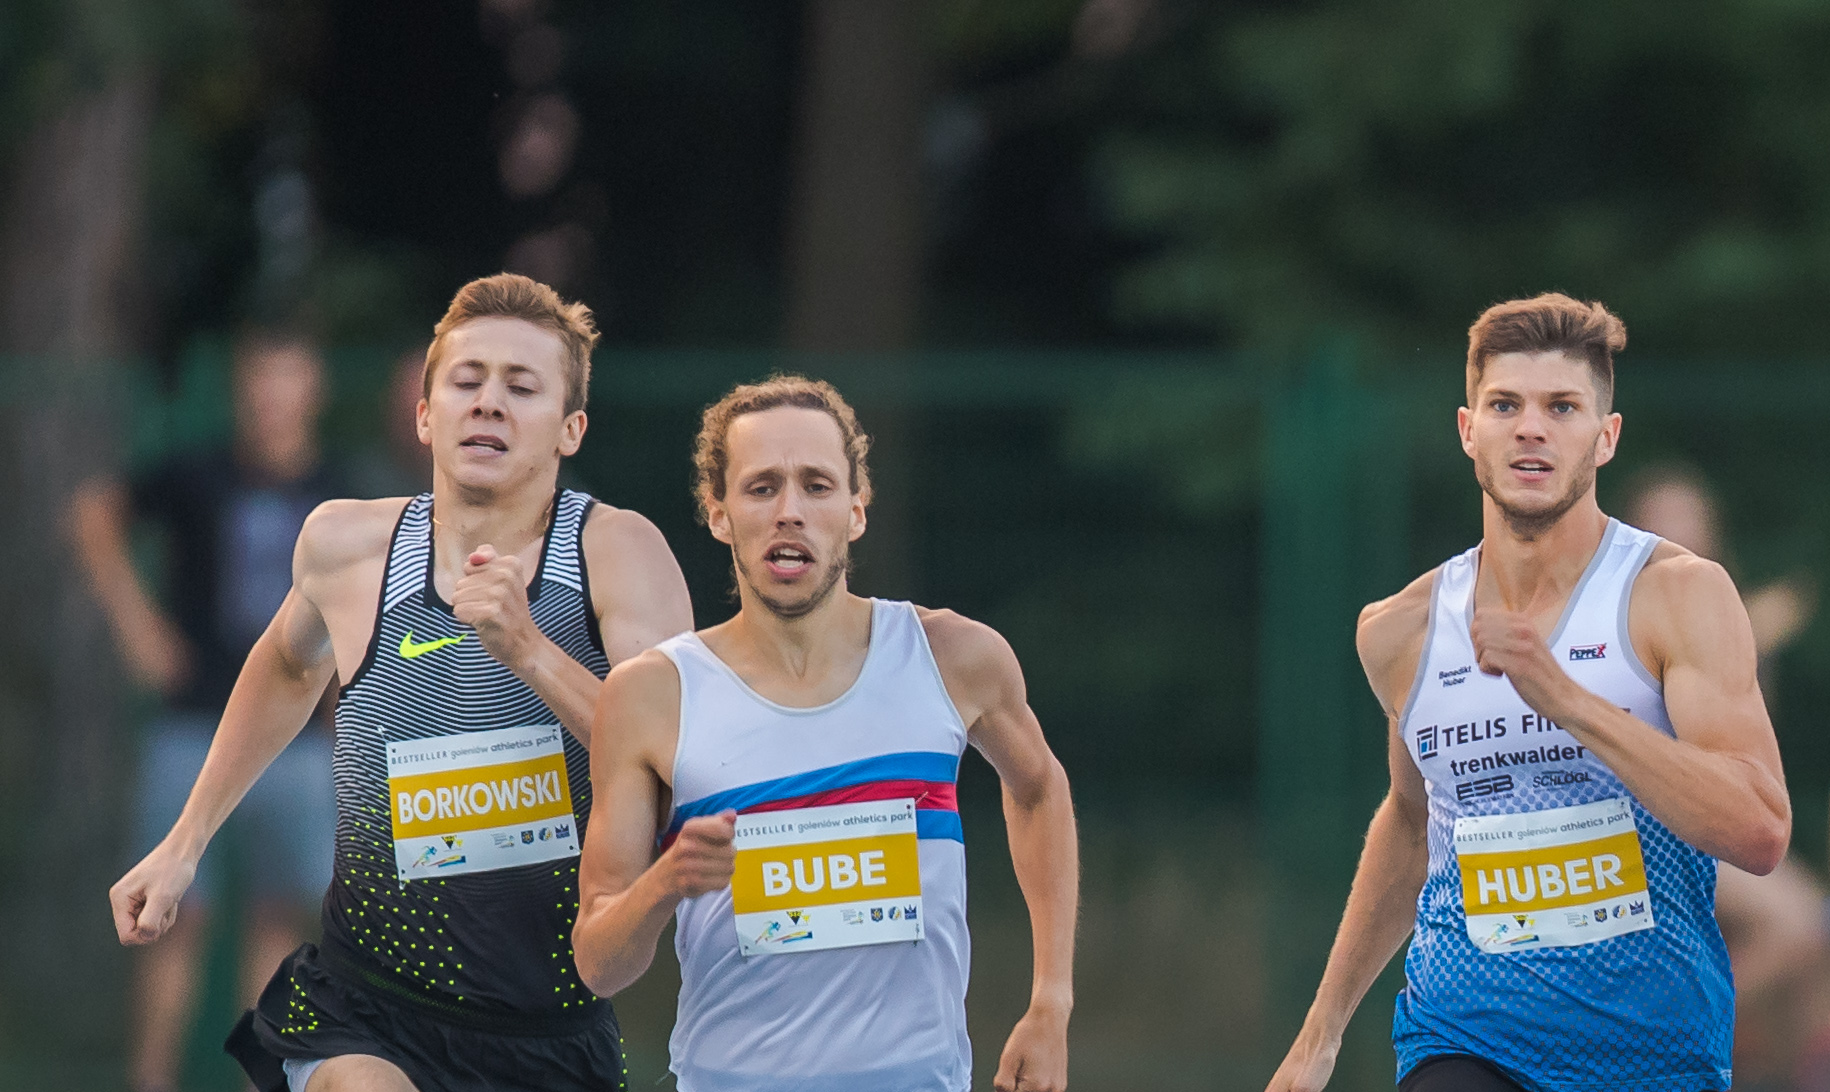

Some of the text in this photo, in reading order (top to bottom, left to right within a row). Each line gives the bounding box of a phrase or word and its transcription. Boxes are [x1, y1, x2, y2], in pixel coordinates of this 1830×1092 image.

[1442, 717, 1507, 747] TELIS
[391, 751, 448, 765] BESTSELLER
[490, 739, 533, 752] athletics
[536, 733, 560, 748] park
[1450, 745, 1586, 777] trenkwalder
[397, 769, 562, 824] BORKOWSKI
[1456, 774, 1514, 801] ESB
[1532, 771, 1593, 788] SCHLÖGL
[736, 823, 794, 838] ESTSELLER
[843, 812, 888, 826] athletics
[891, 811, 913, 824] park
[1456, 830, 1515, 842] BESTSELLER
[1560, 816, 1604, 832] athletics
[1607, 811, 1631, 825] park
[761, 849, 888, 897] BUBE
[1476, 853, 1625, 905] HUBER
